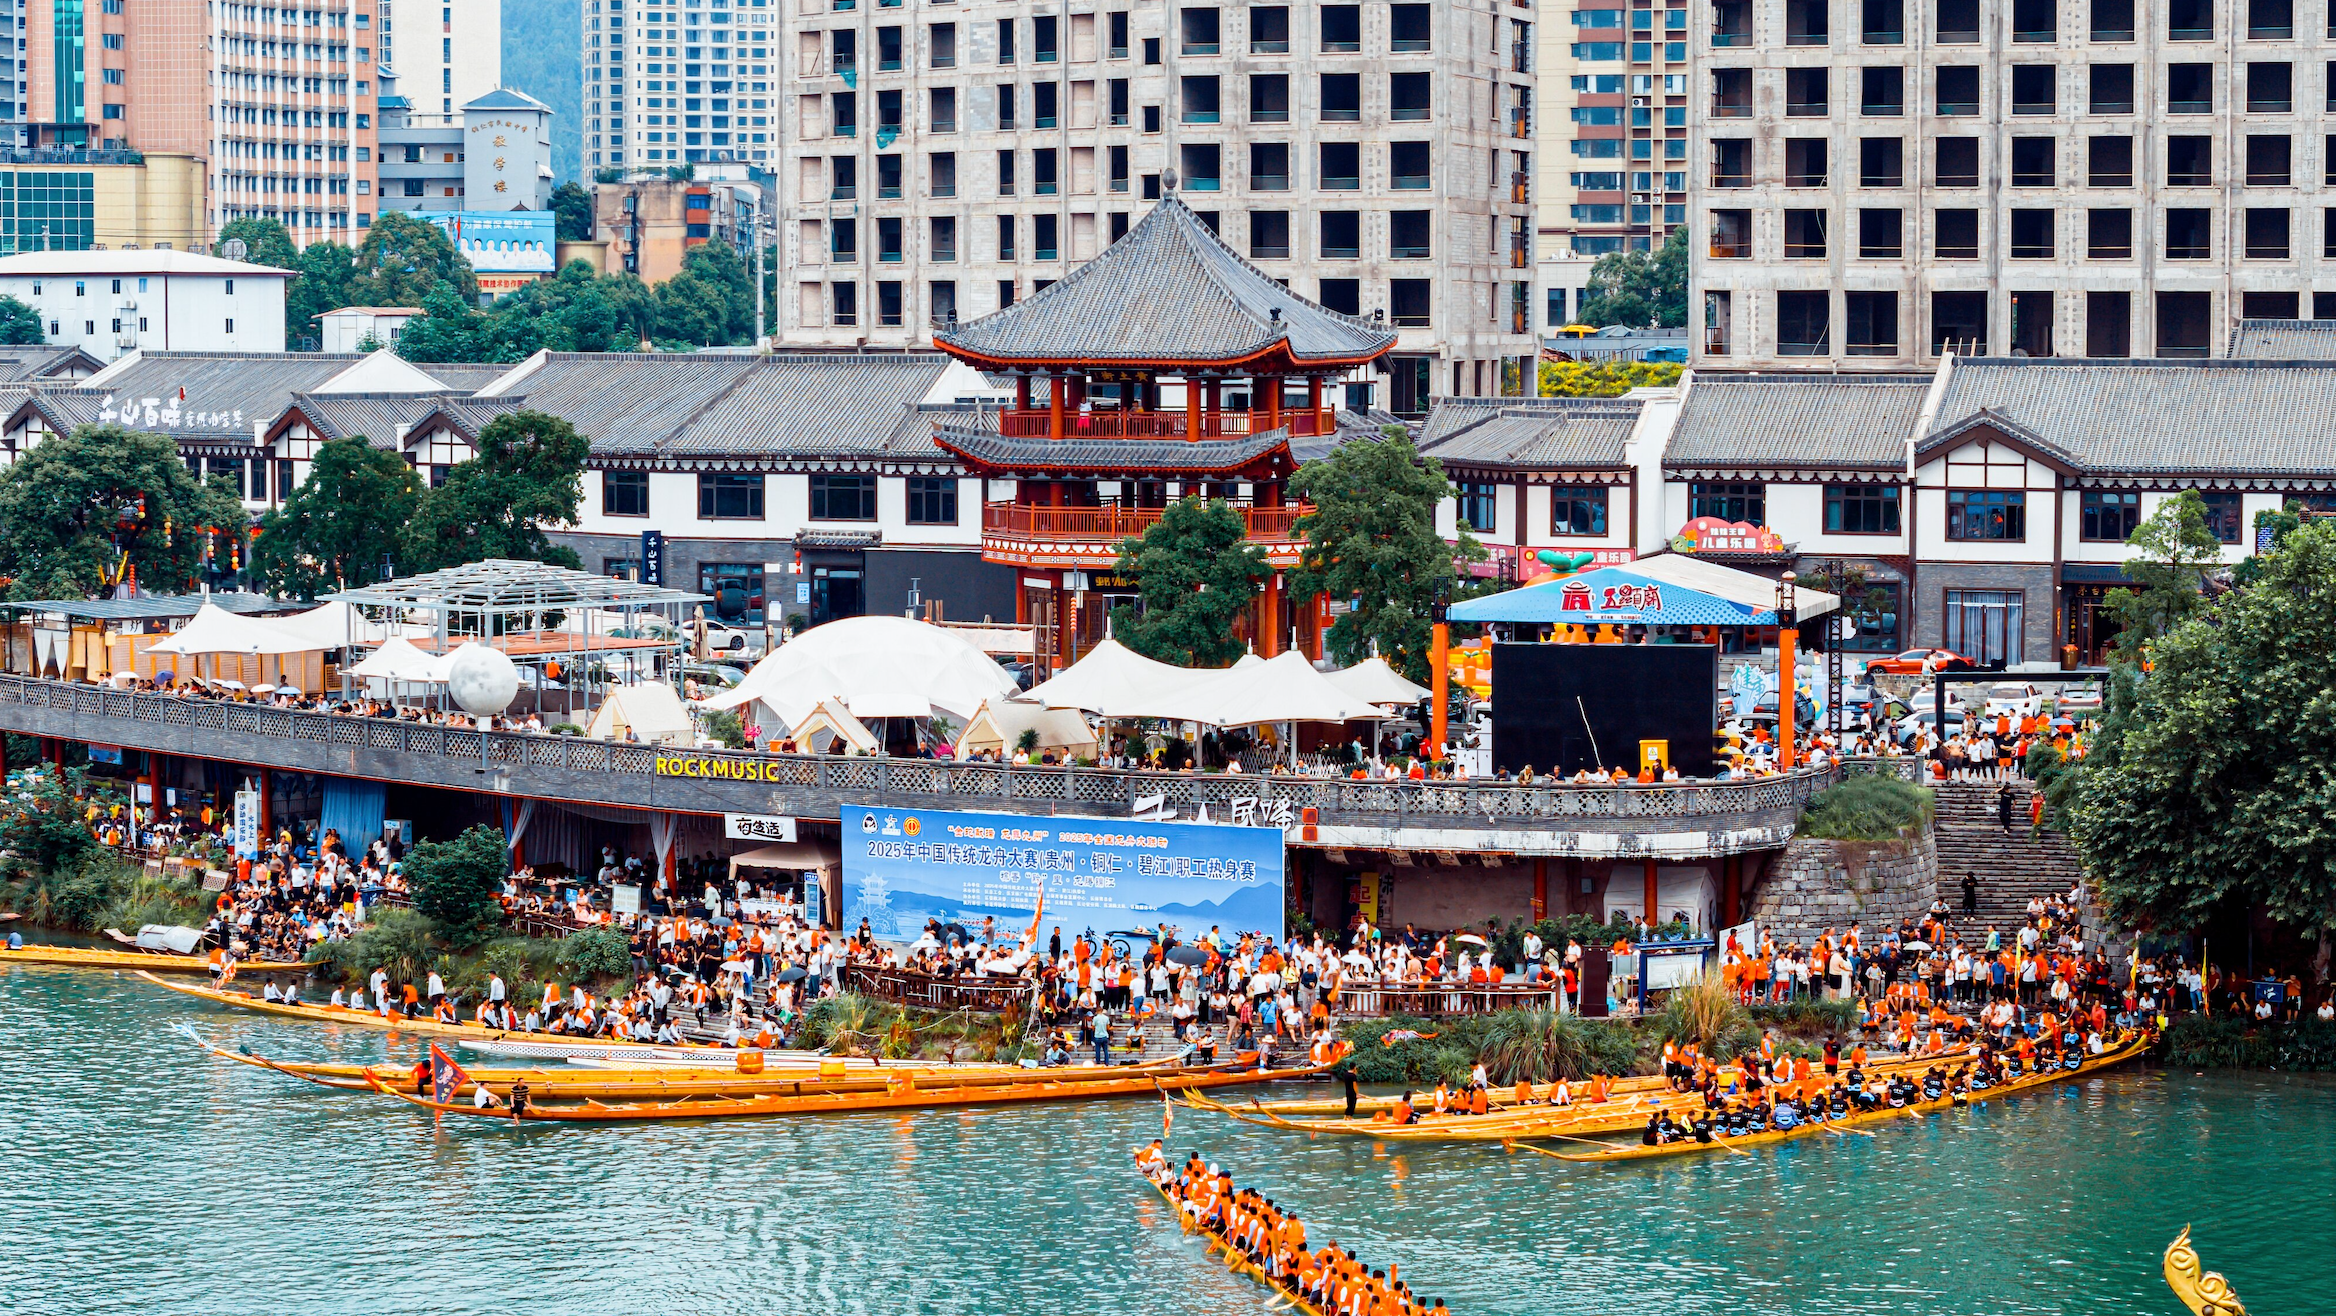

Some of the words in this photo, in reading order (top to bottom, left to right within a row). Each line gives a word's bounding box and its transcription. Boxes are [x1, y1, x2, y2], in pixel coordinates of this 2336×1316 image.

[492, 135, 508, 193] 教学楼
[99, 394, 181, 427] 千山百味
[1702, 537, 1756, 549] 儿童乐园
[648, 537, 657, 583] 千山百味
[656, 757, 779, 781] ROCKMUSIC
[736, 817, 784, 839] 夜生活
[1058, 832, 1169, 848] 2025年全国龙舟大联动
